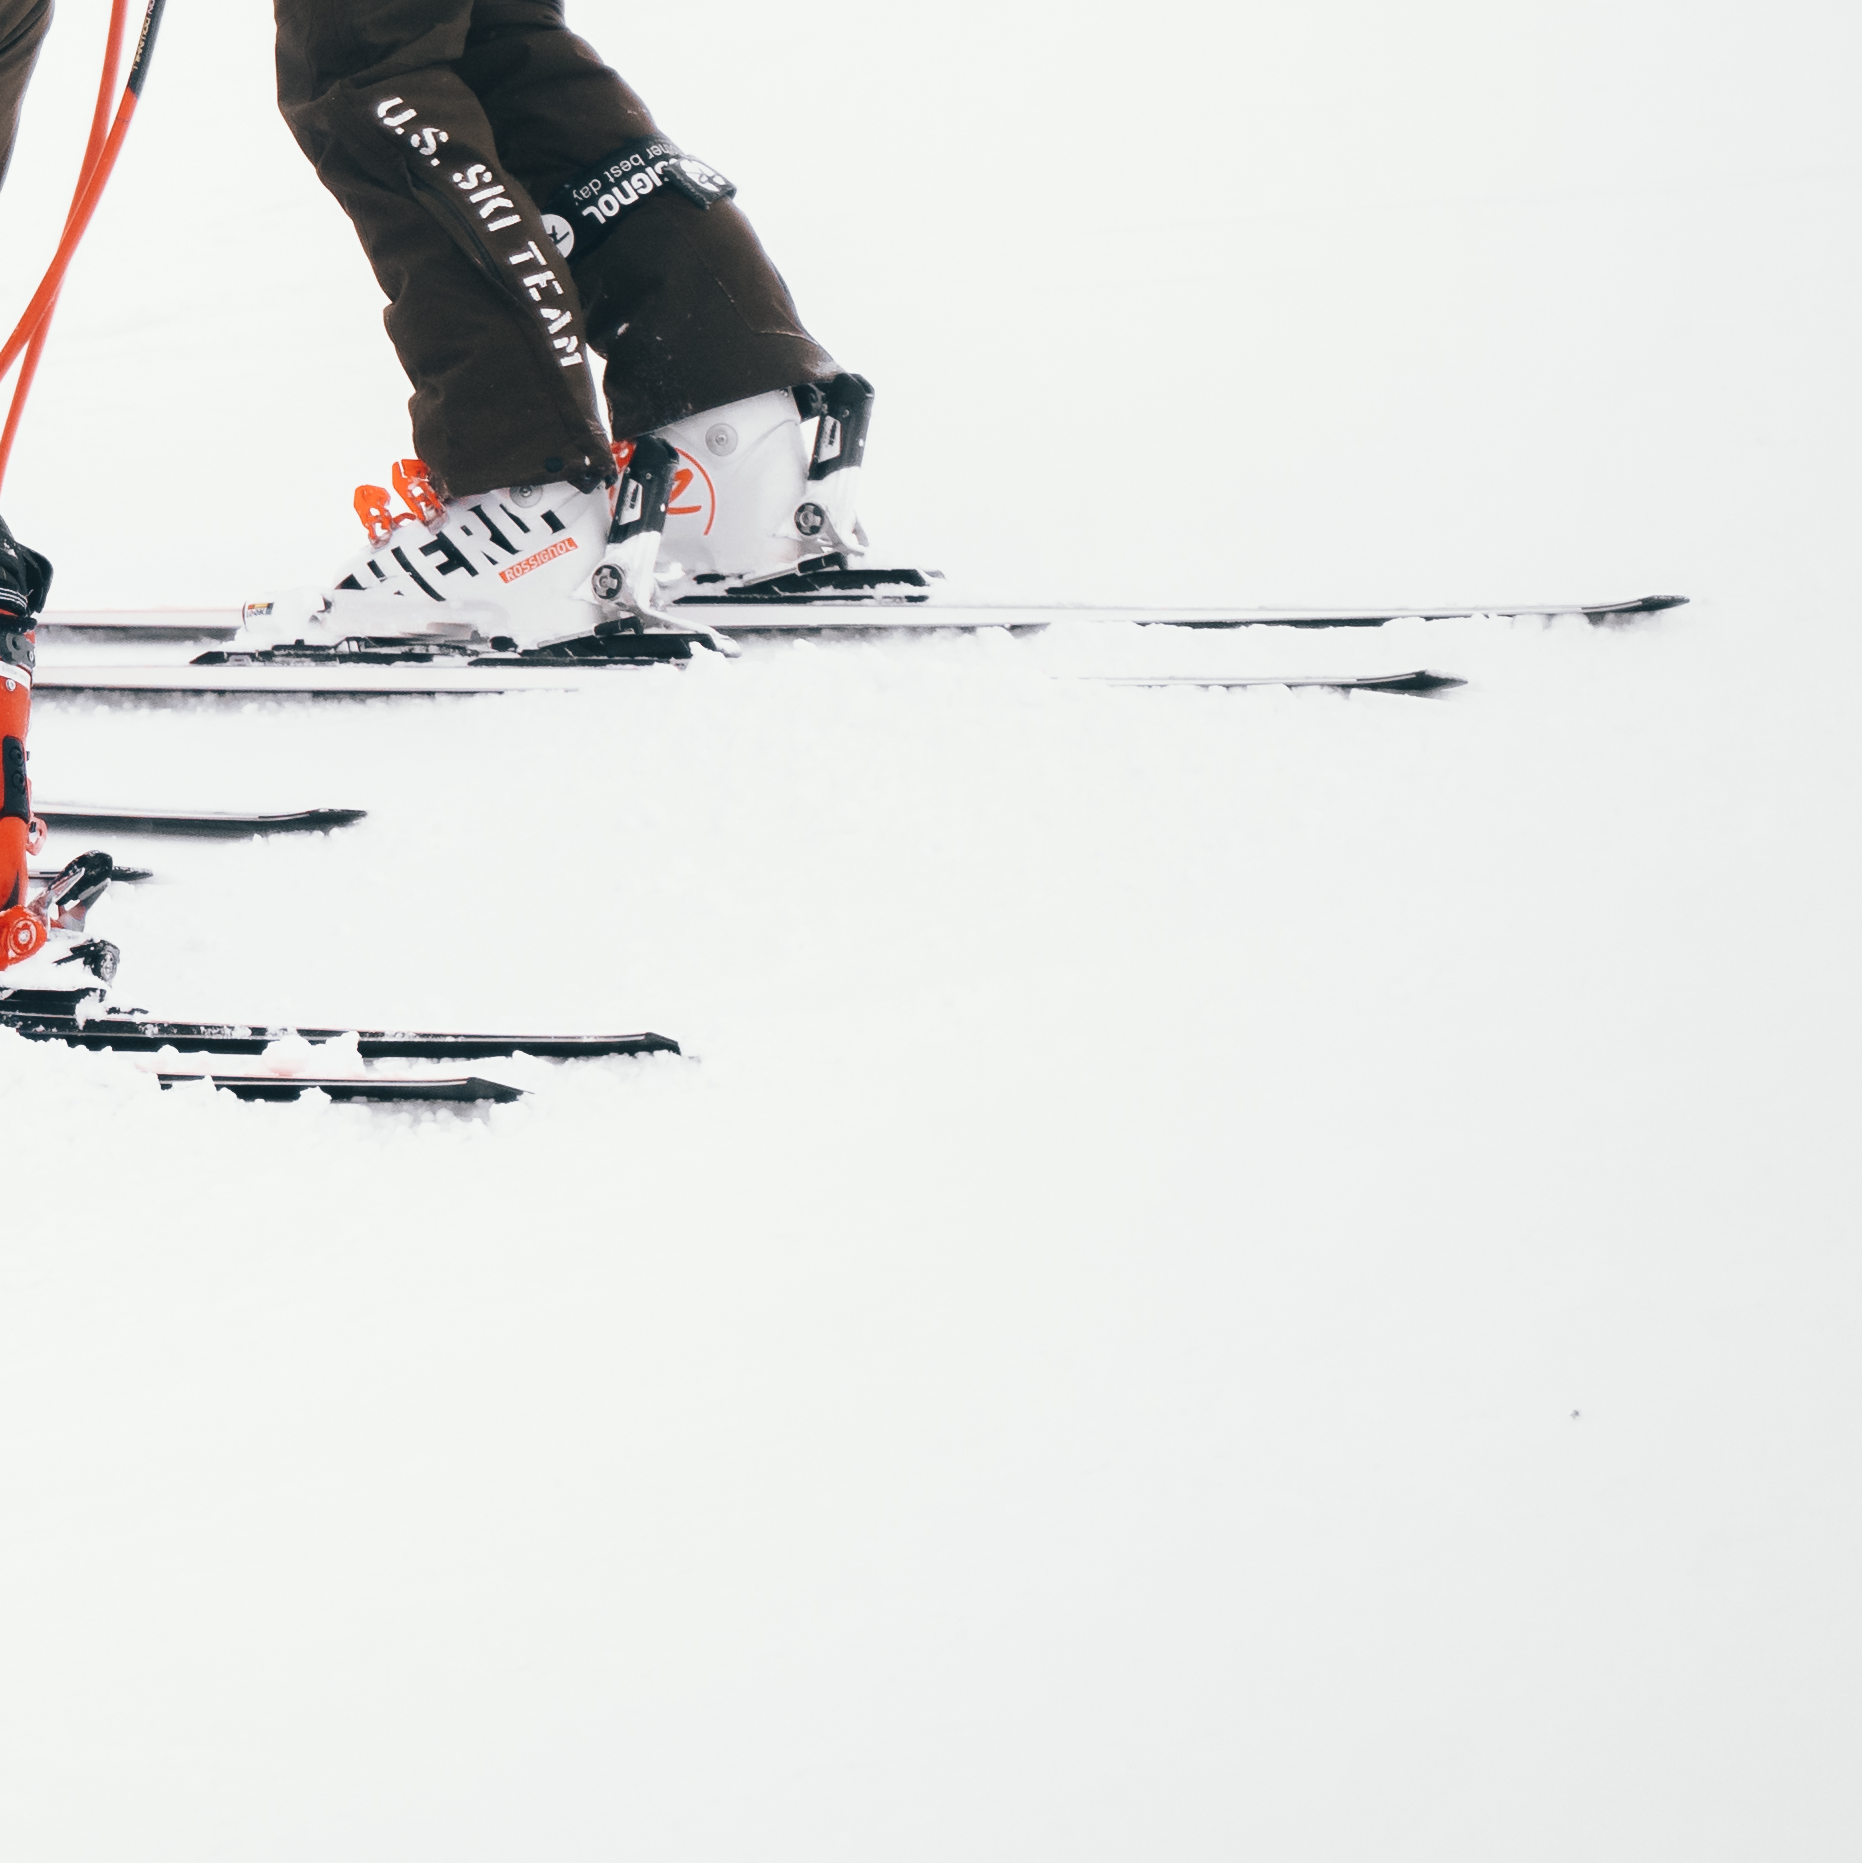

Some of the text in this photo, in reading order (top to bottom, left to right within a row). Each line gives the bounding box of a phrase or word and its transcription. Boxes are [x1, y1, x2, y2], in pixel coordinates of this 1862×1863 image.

[604, 153, 645, 184] best
[572, 178, 602, 206] day
[376, 96, 584, 367] U.S. SKI TEAM
[504, 540, 576, 583] ROSSIGNOL
